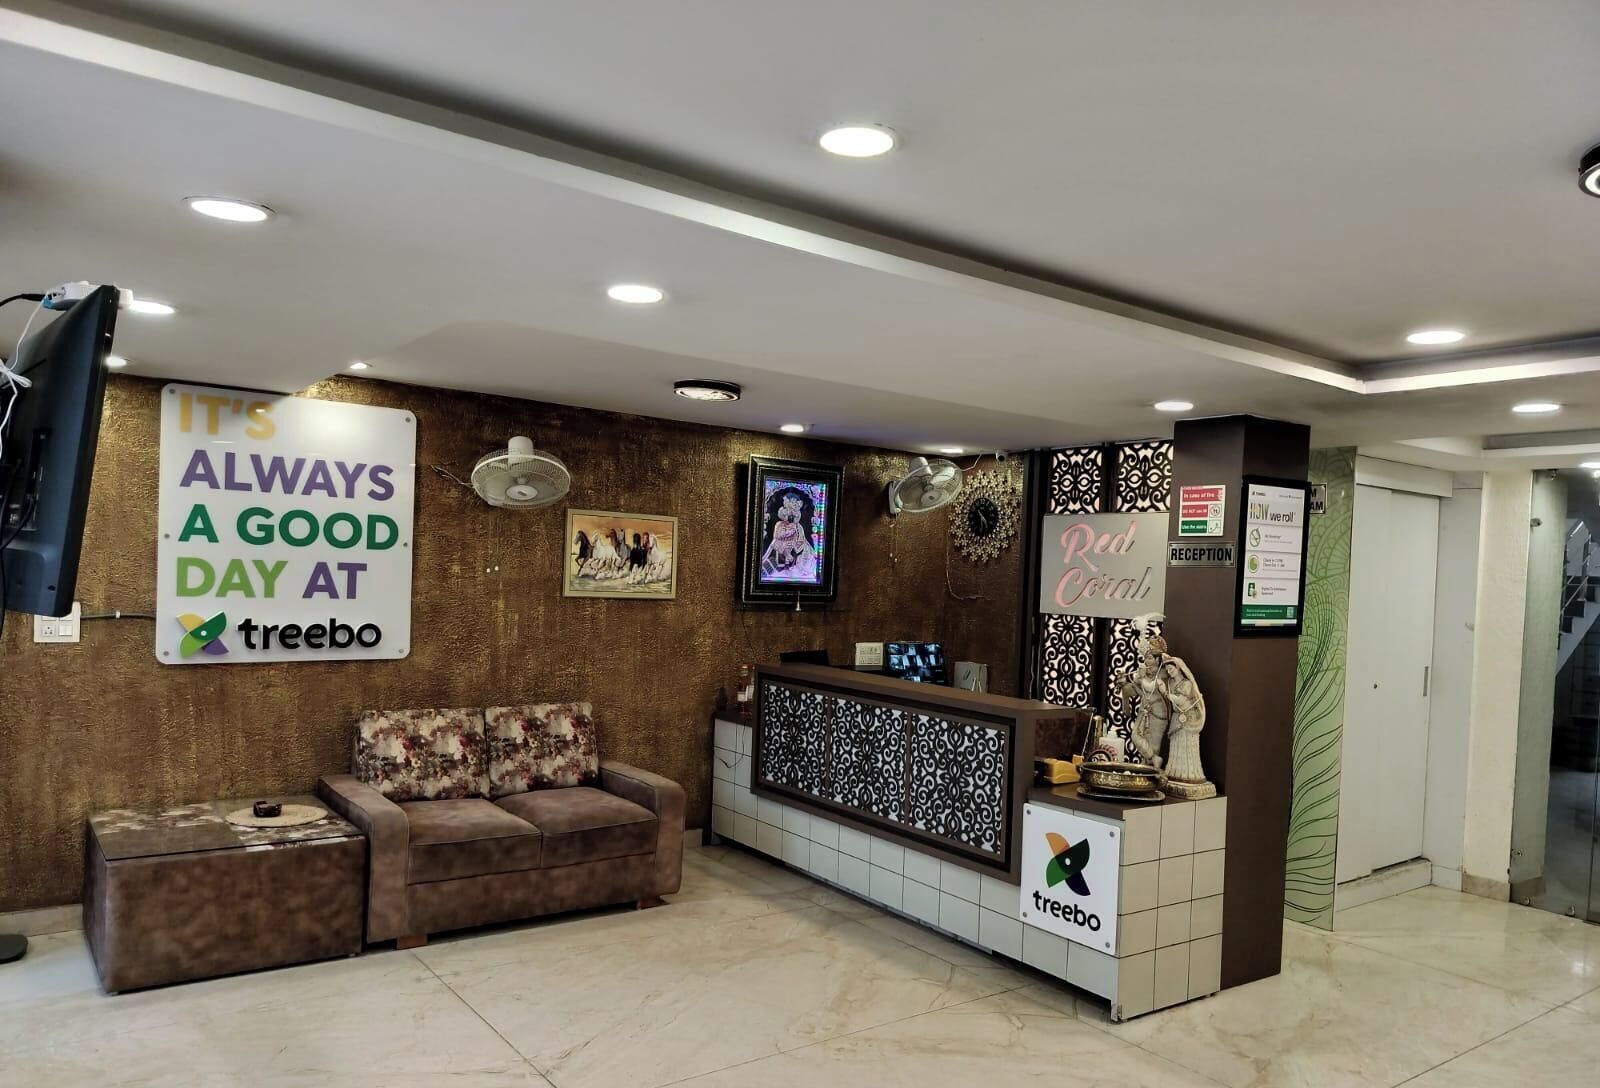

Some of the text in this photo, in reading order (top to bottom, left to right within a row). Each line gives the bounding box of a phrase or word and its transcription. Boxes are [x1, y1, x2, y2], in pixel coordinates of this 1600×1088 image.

[178, 392, 276, 441] IT'S
[179, 449, 394, 501] ALWAYS
[178, 503, 399, 550] A GOOD
[1270, 512, 1282, 522] we
[1282, 511, 1294, 523] roll
[1060, 520, 1137, 572] Red
[1170, 547, 1232, 562] RECEPTION
[176, 557, 368, 600] DAY AT
[1055, 566, 1153, 608] Coral
[237, 617, 383, 650] treebo
[1033, 889, 1101, 932] treebo
